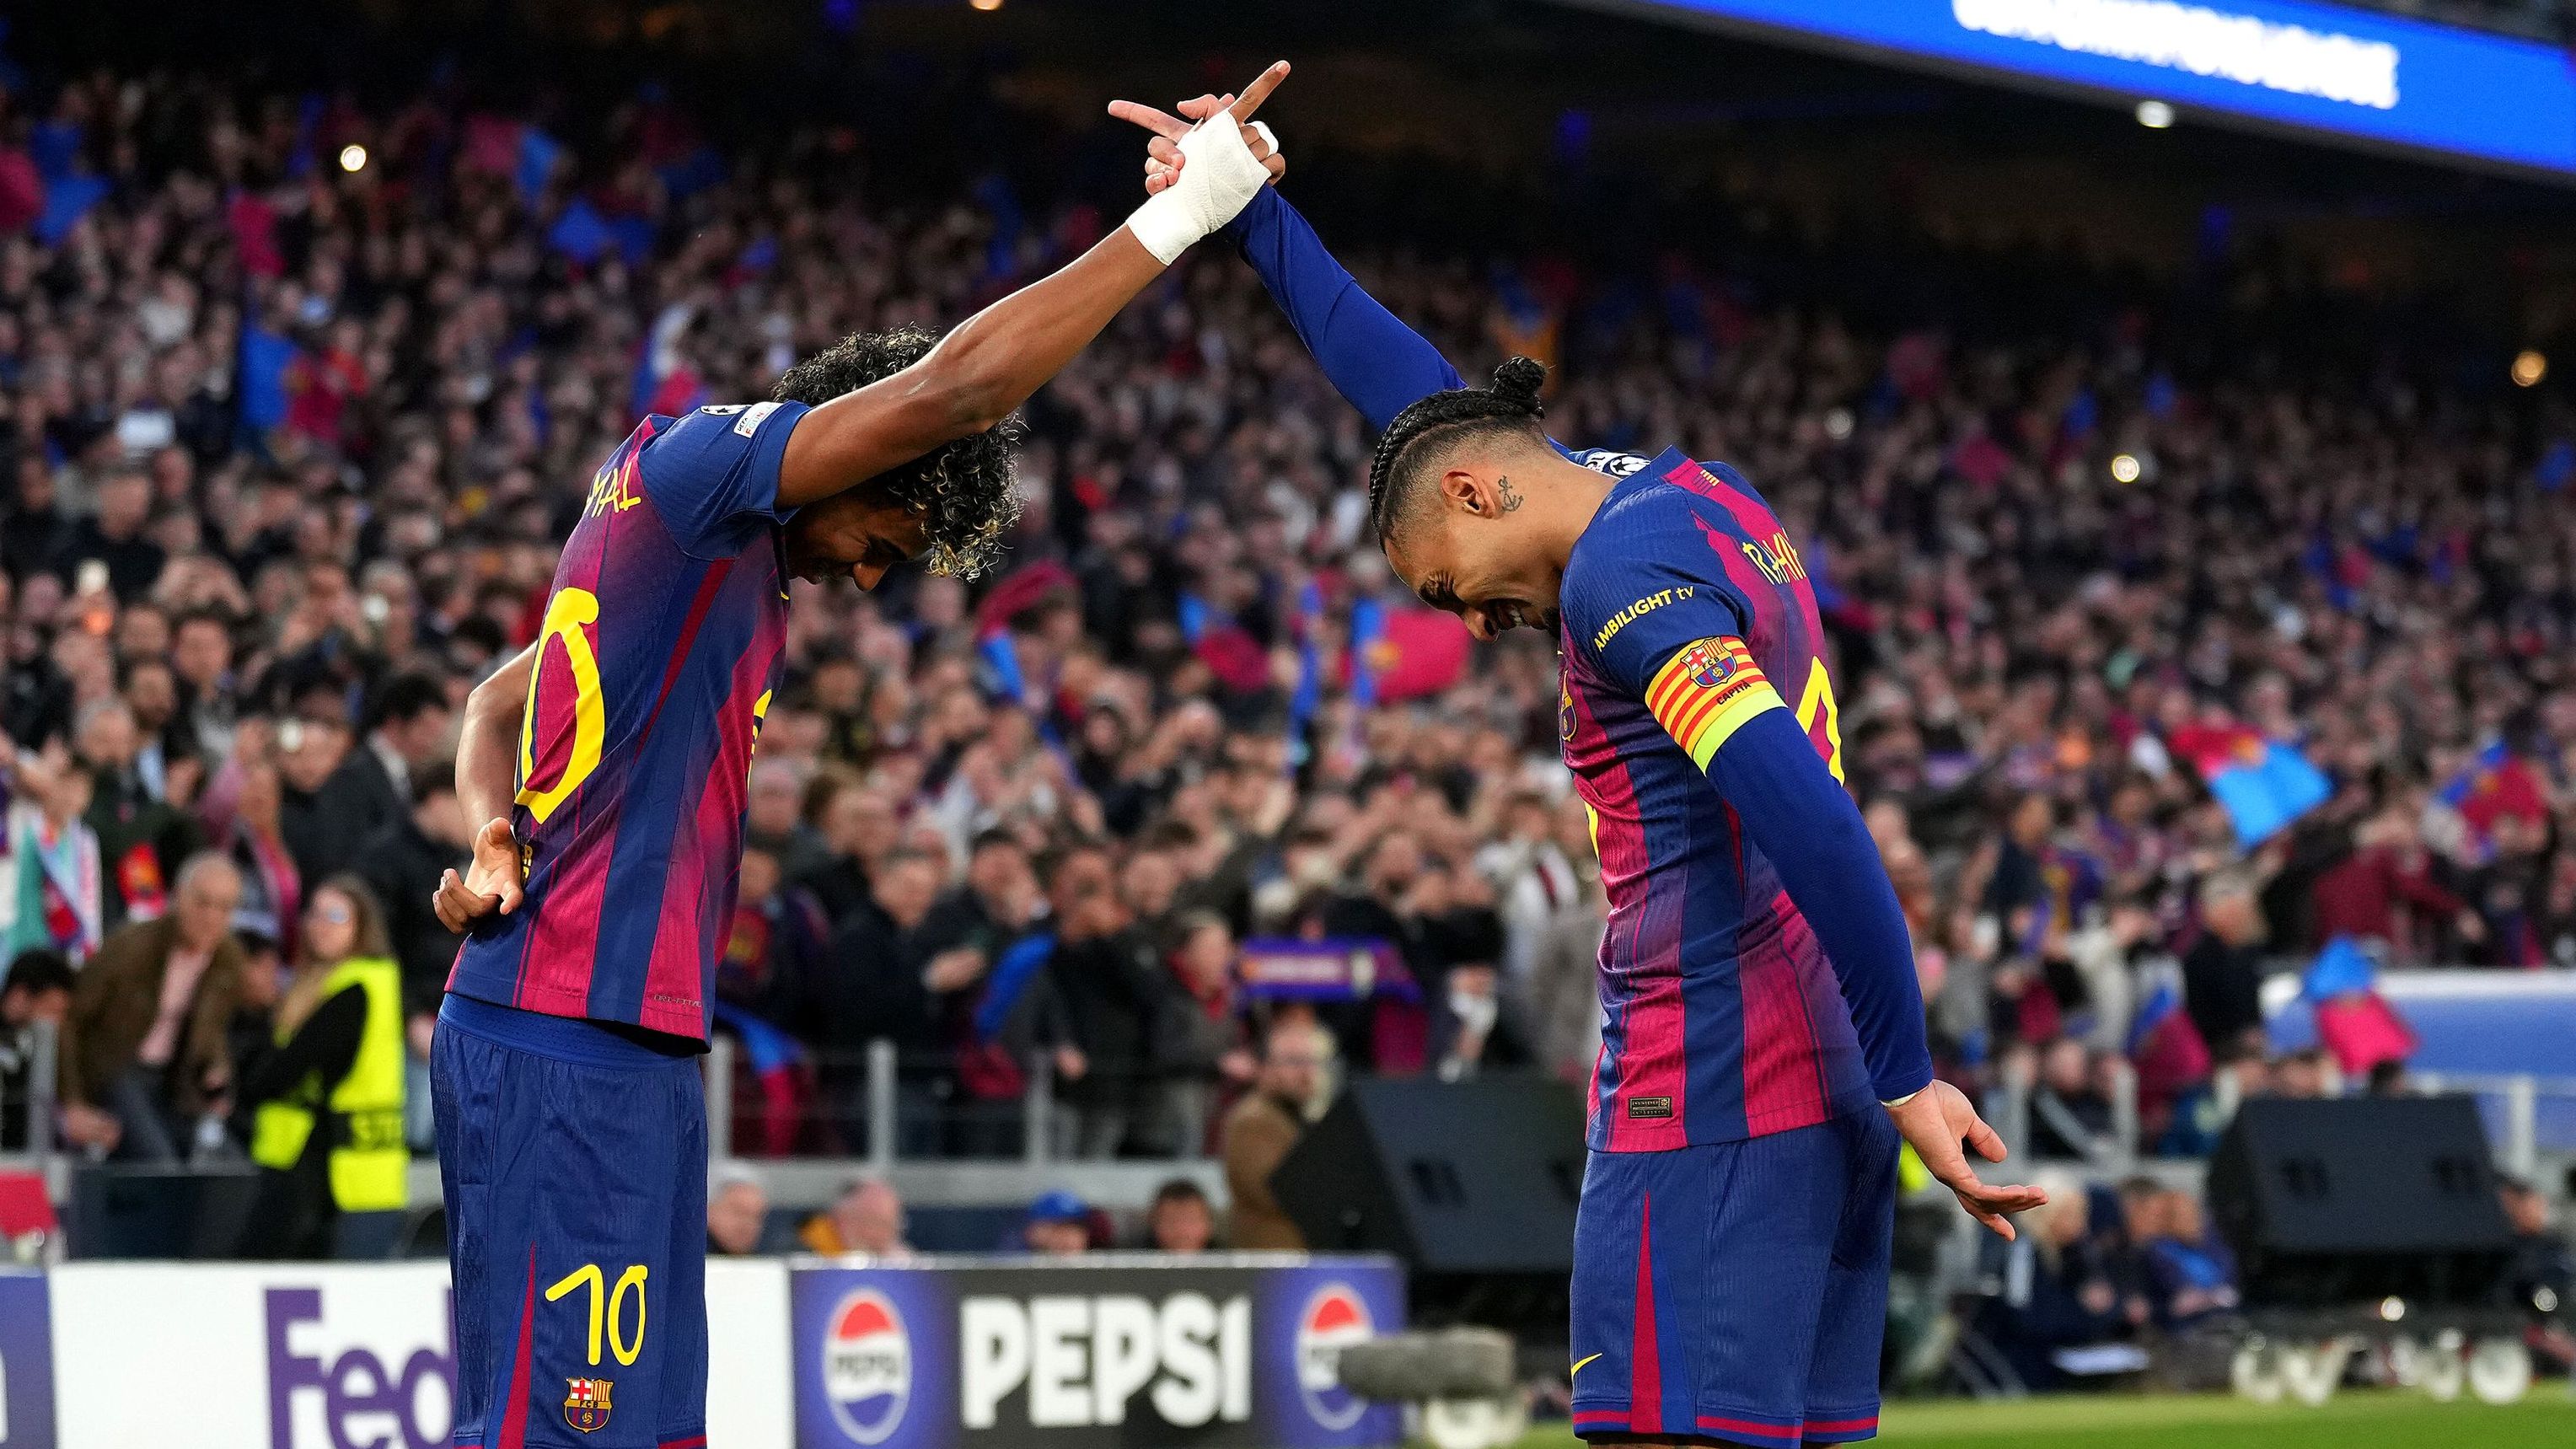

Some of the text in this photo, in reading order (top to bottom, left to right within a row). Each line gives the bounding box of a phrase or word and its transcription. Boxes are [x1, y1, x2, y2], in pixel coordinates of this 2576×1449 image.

[584, 461, 641, 518] MAL
[1594, 586, 1693, 652] AMBILIGHT tv
[1702, 657, 1720, 670] FCB
[545, 1264, 648, 1366] 10
[961, 1291, 1252, 1430] PEPSI
[580, 1400, 598, 1409] FCB
